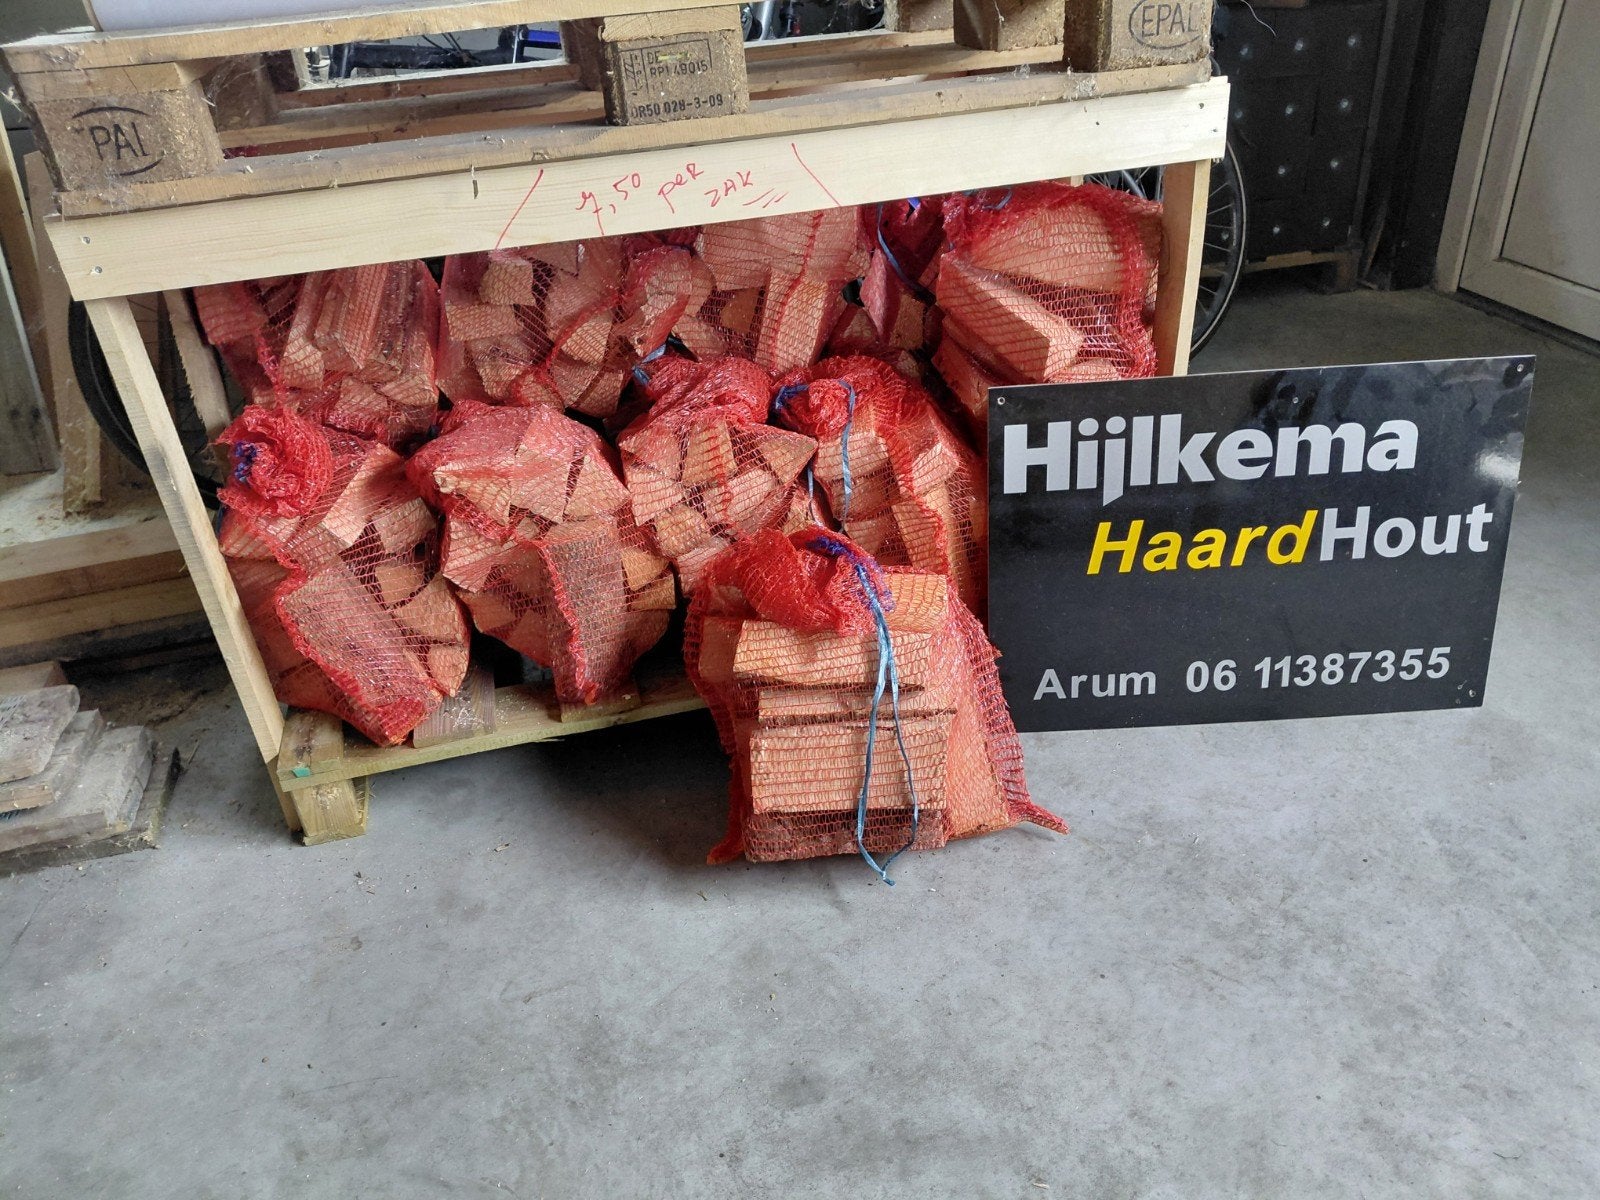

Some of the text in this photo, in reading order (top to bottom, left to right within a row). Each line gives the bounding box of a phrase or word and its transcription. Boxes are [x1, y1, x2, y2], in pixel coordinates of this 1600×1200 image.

[1141, 3, 1199, 38] EPAL
[1003, 413, 1419, 507] Hijlkema
[1086, 503, 1494, 576] HaardHout
[1033, 646, 1452, 701] Arum 06 11387355
